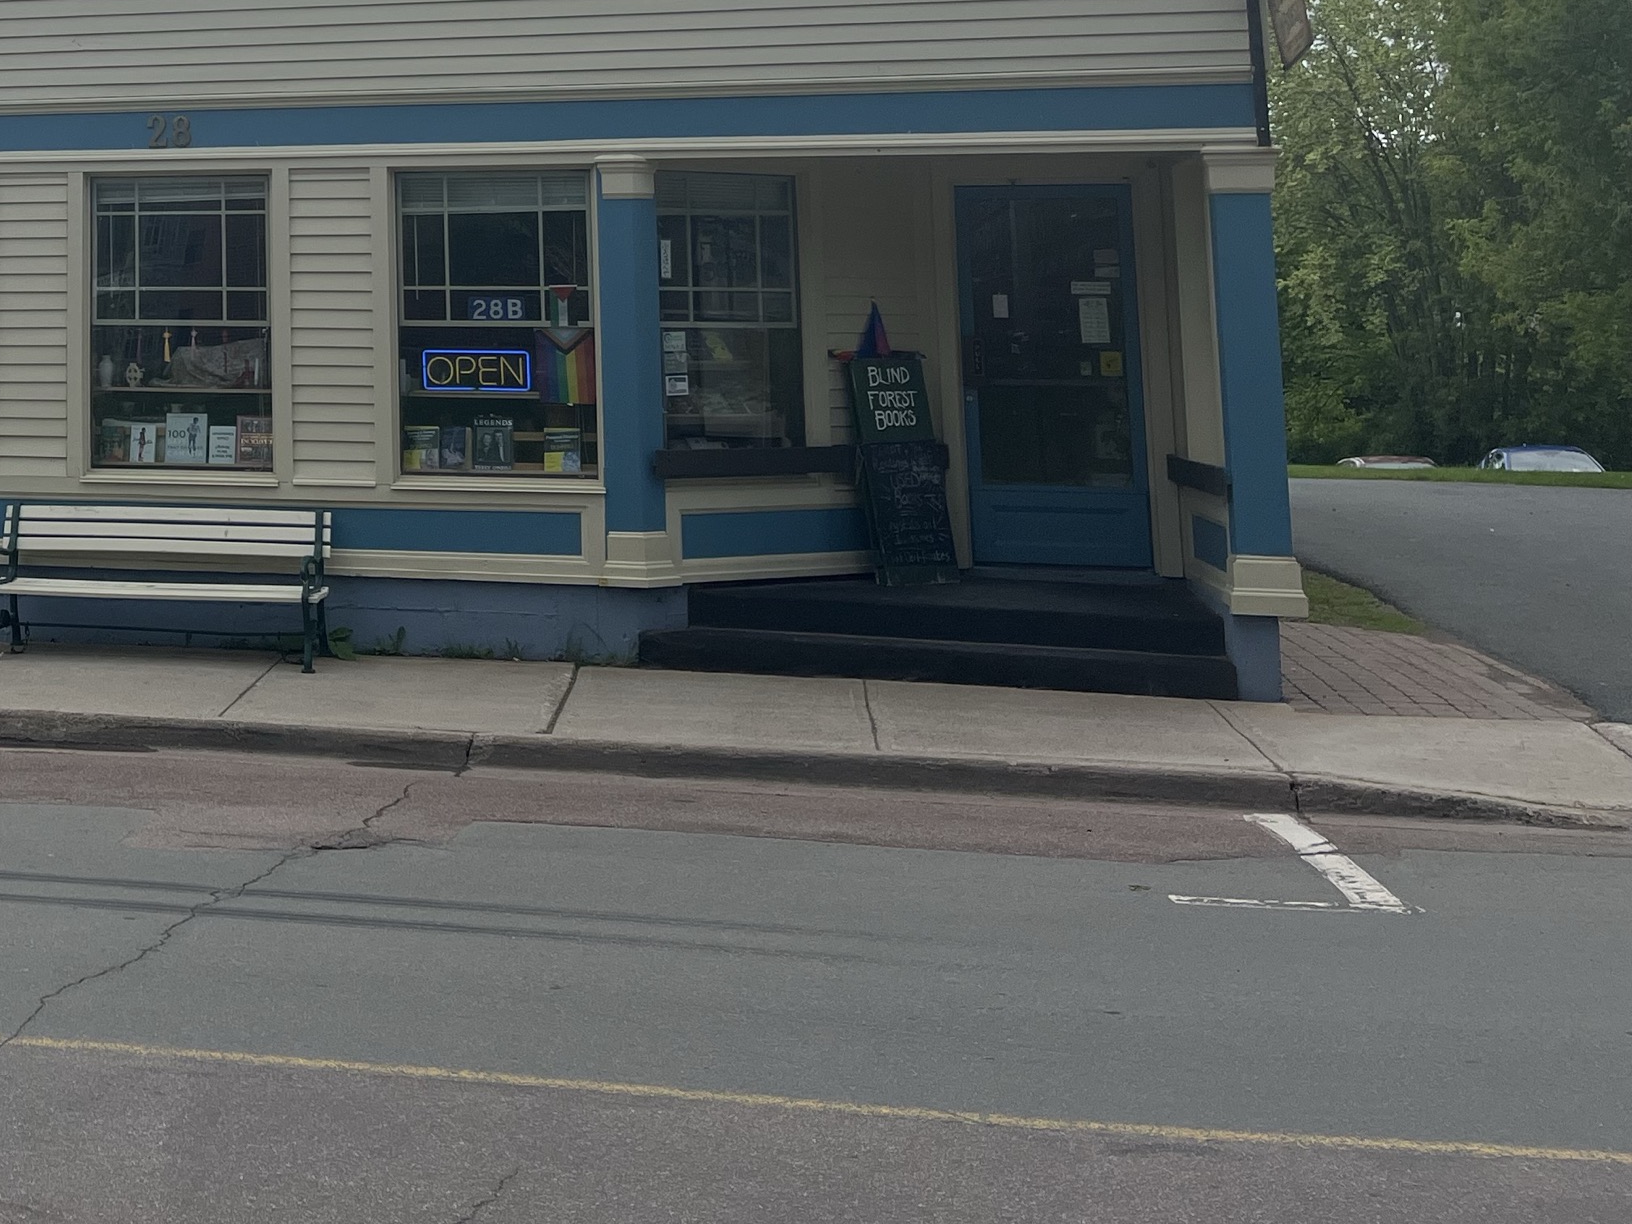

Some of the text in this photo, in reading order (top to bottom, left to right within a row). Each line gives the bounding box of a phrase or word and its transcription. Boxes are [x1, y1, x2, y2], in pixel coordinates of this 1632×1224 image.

[146, 114, 192, 148] 28
[472, 299, 523, 320] 28B
[427, 356, 524, 385] OPEN
[867, 366, 911, 387] BLIND
[867, 390, 918, 410] FOREST
[473, 418, 514, 426] LEGENDS
[874, 409, 917, 431] BOOKS
[168, 429, 186, 439] 100
